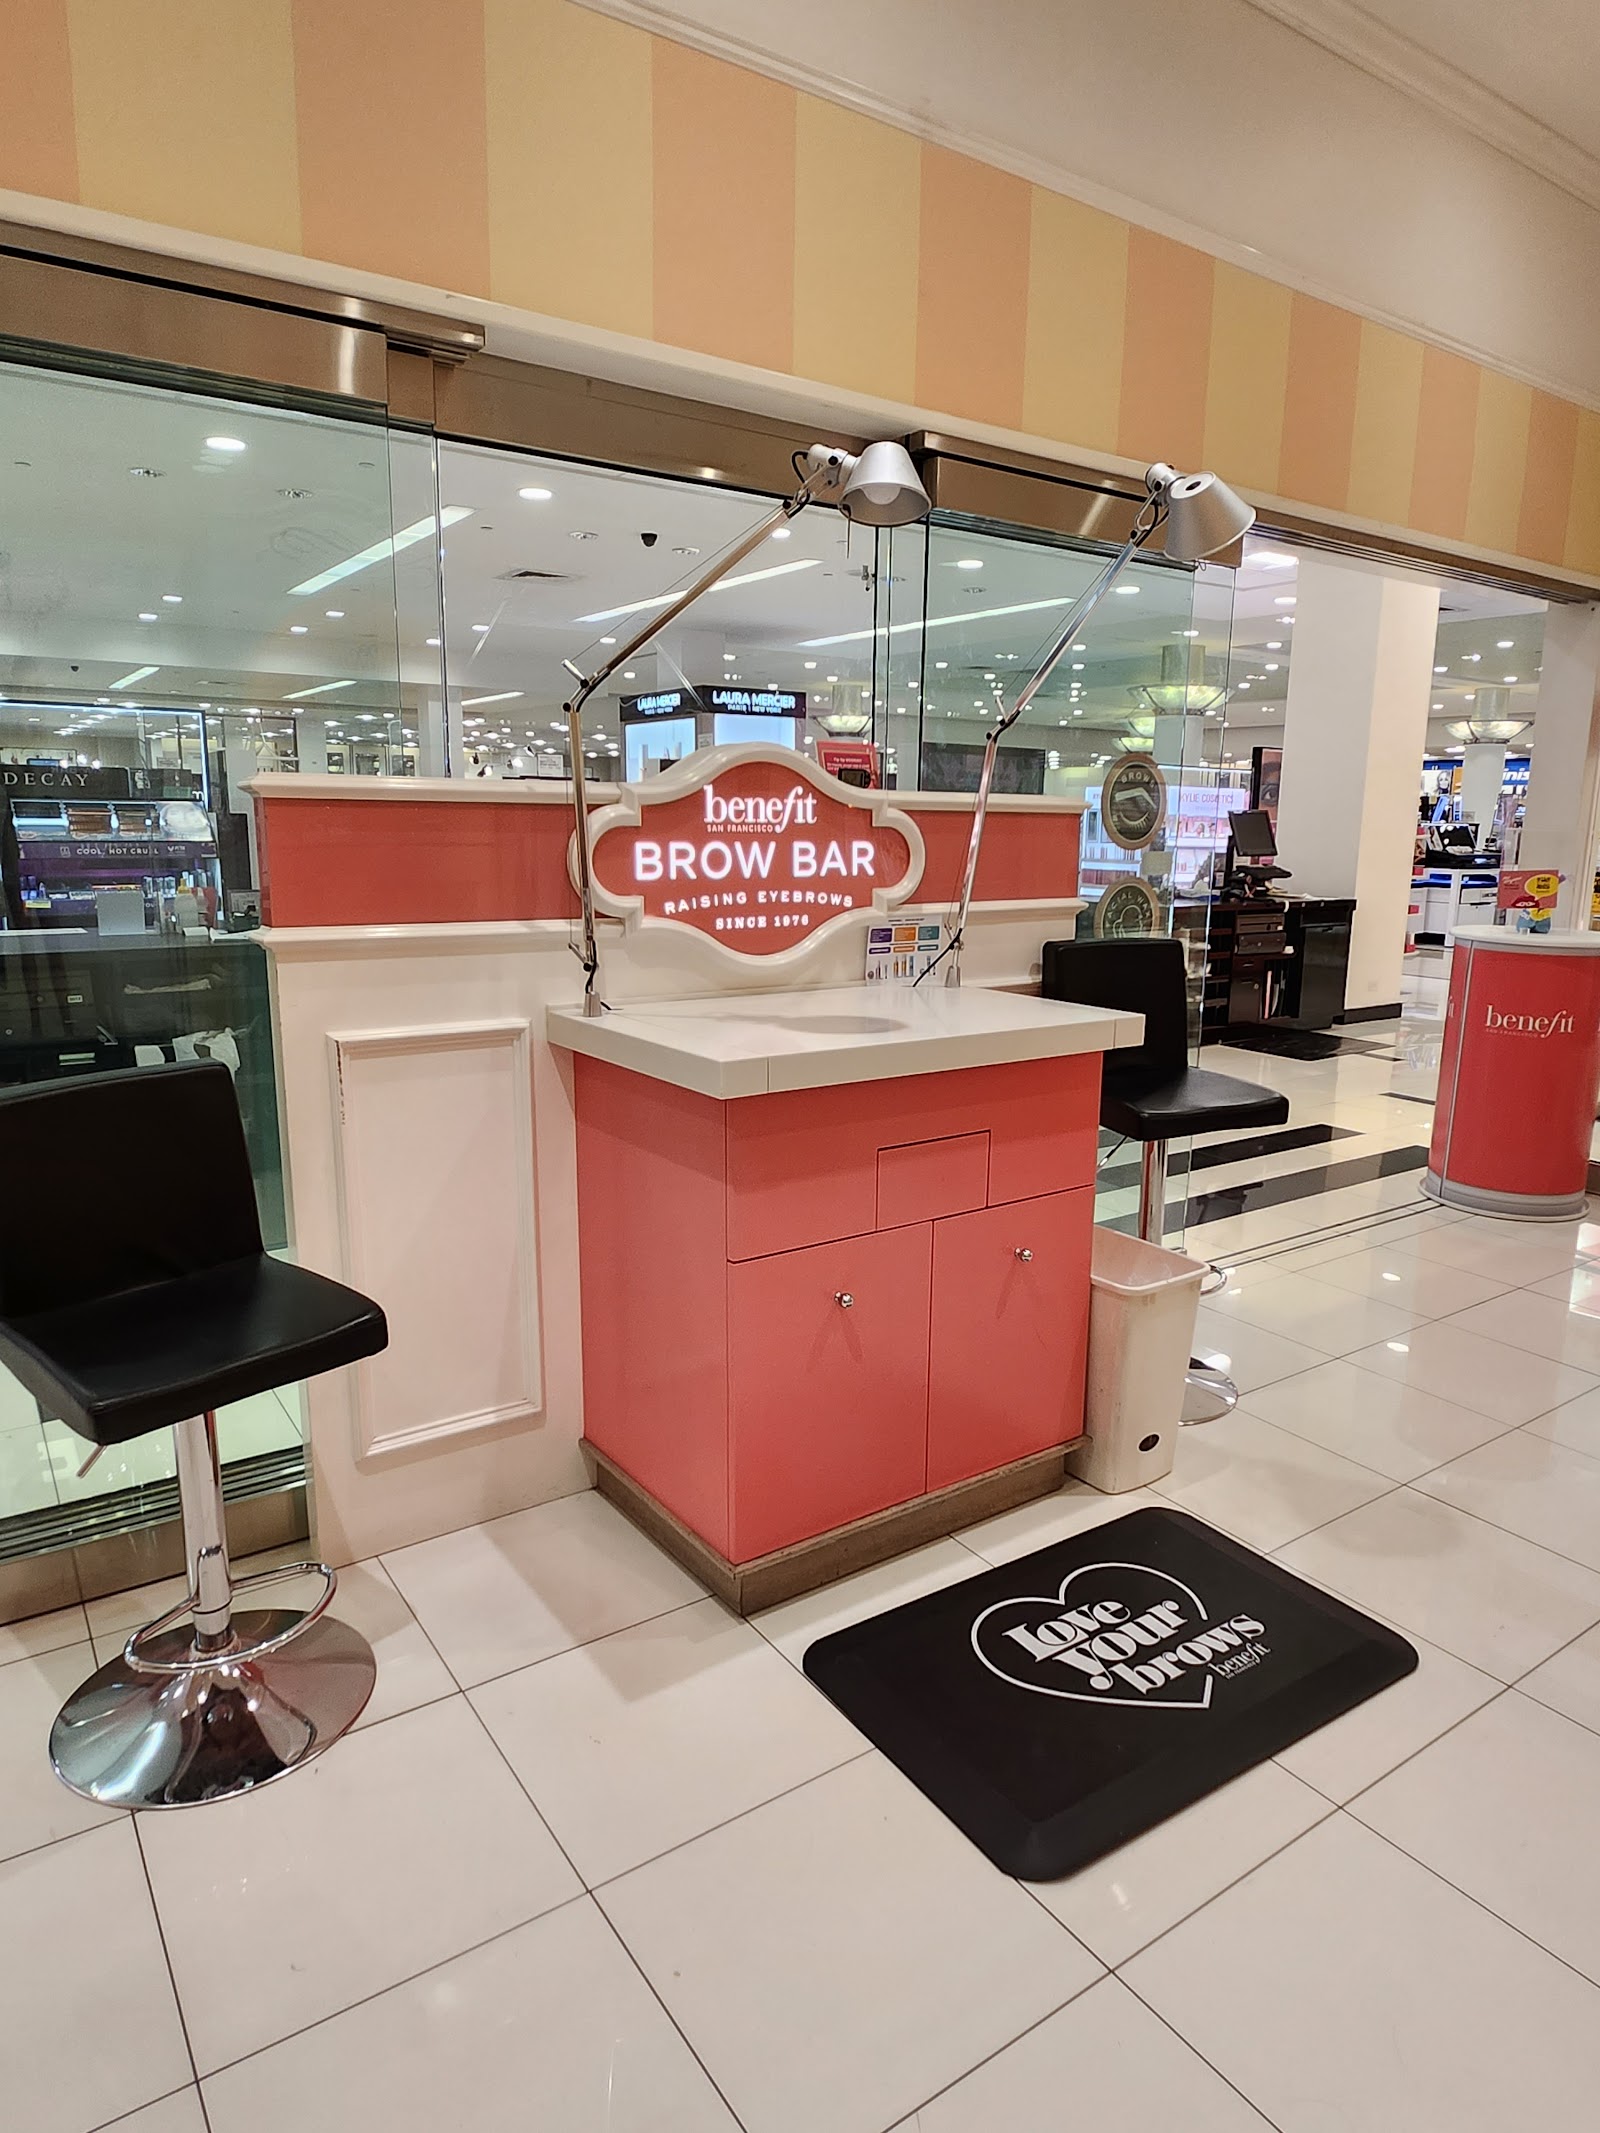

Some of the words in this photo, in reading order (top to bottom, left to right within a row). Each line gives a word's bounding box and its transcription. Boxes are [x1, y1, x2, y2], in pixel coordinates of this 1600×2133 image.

[712, 690, 751, 706] LAURA
[751, 692, 796, 710] MERCIER
[4, 773, 89, 787] DECAY
[1121, 771, 1156, 788] BROWS
[703, 784, 818, 834] benefit
[707, 824, 724, 833] SAN
[727, 824, 774, 833] FRANCISCO
[130, 847, 160, 855] CRUL
[634, 840, 776, 881] BROW
[792, 840, 875, 878] BAR
[664, 891, 748, 915] RAISING
[757, 890, 853, 908] EYEBROWS
[715, 917, 767, 930] SINCE
[774, 914, 809, 927] 1976
[1485, 1005, 1575, 1039] benefit
[1002, 1601, 1131, 1662] Love
[1052, 1600, 1188, 1690] your
[1108, 1613, 1265, 1695] brows
[1207, 1642, 1271, 1677] benefit
